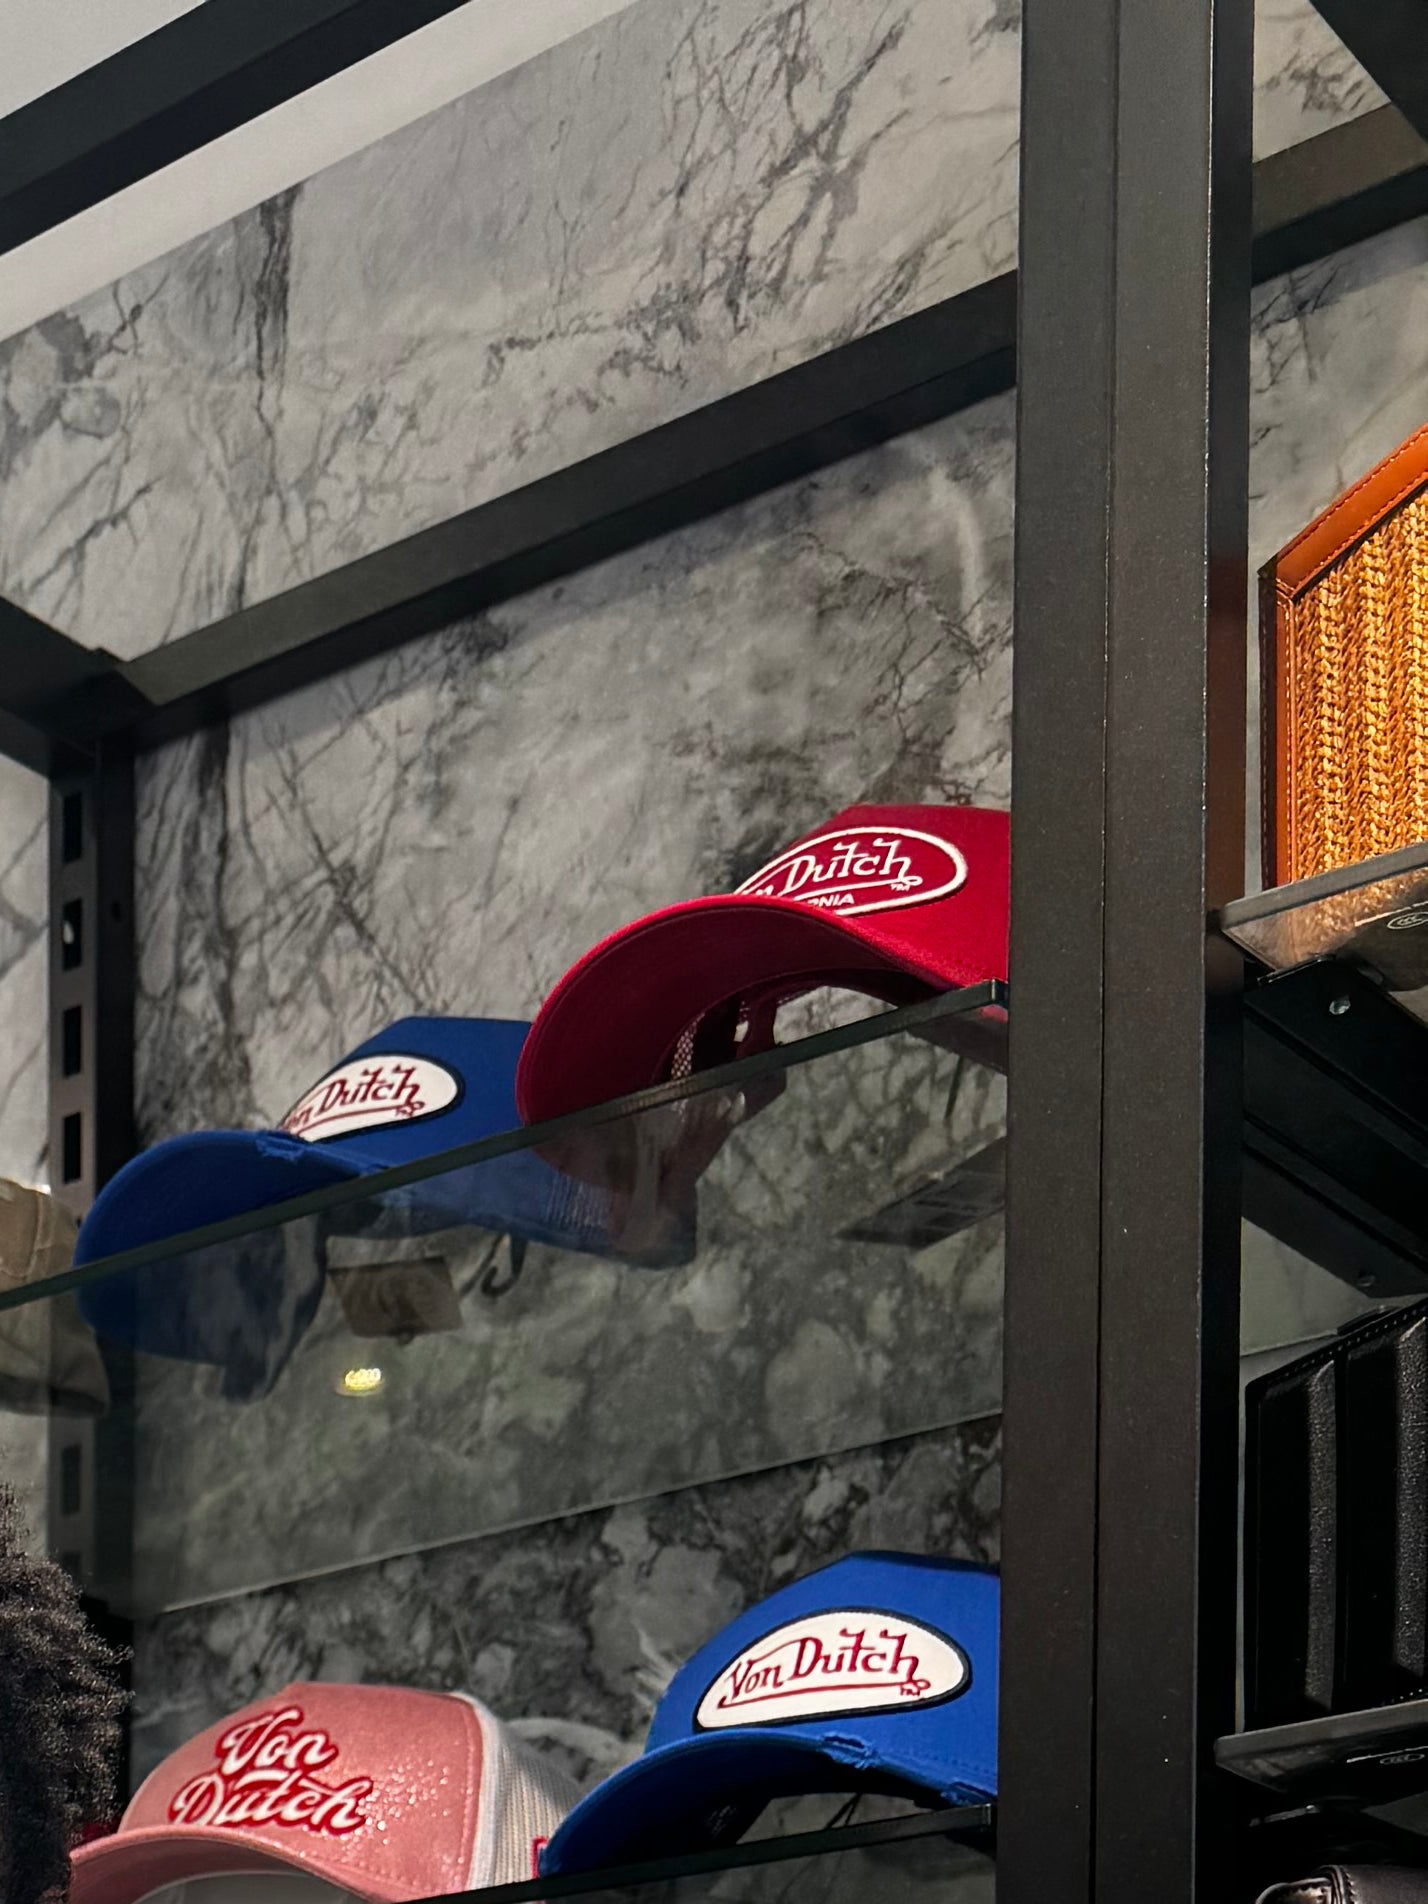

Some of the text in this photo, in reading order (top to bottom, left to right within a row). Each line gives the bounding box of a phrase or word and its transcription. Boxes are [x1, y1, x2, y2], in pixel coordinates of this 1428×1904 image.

[779, 837, 914, 896] Dutch
[314, 1064, 424, 1117] Dutch
[723, 1657, 784, 1701] Von
[787, 1627, 926, 1683] Dutch
[217, 1705, 339, 1776] Von
[169, 1768, 374, 1832] Dutch
